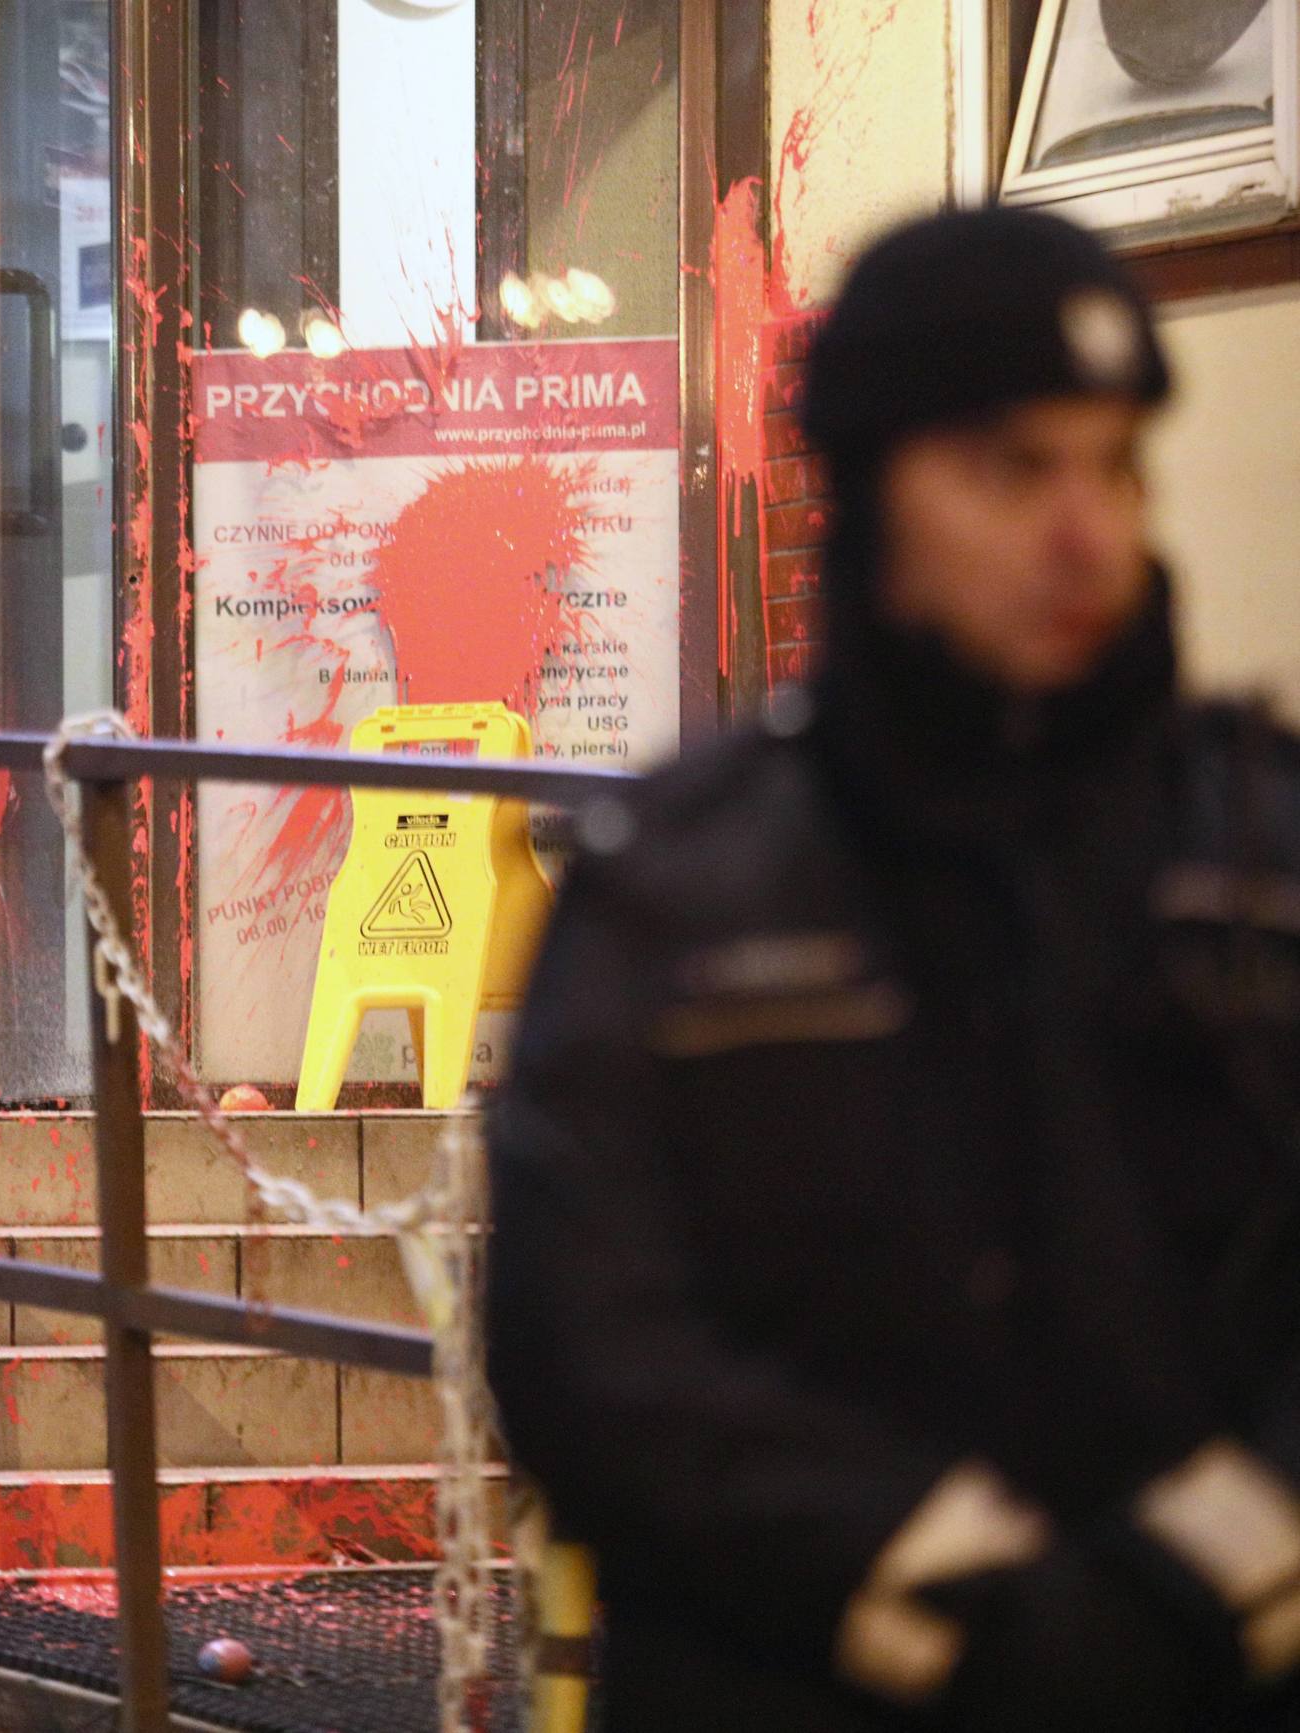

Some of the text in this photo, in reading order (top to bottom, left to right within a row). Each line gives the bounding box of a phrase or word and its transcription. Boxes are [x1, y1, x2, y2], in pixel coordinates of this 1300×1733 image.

[206, 371, 647, 419] PRZYCHODNIA PRIMA
[213, 523, 298, 544] CZYNNE
[577, 693, 629, 711] pracy
[587, 715, 629, 732] USG
[384, 832, 457, 849] CAUTION
[358, 940, 449, 957] WET FLOOR
